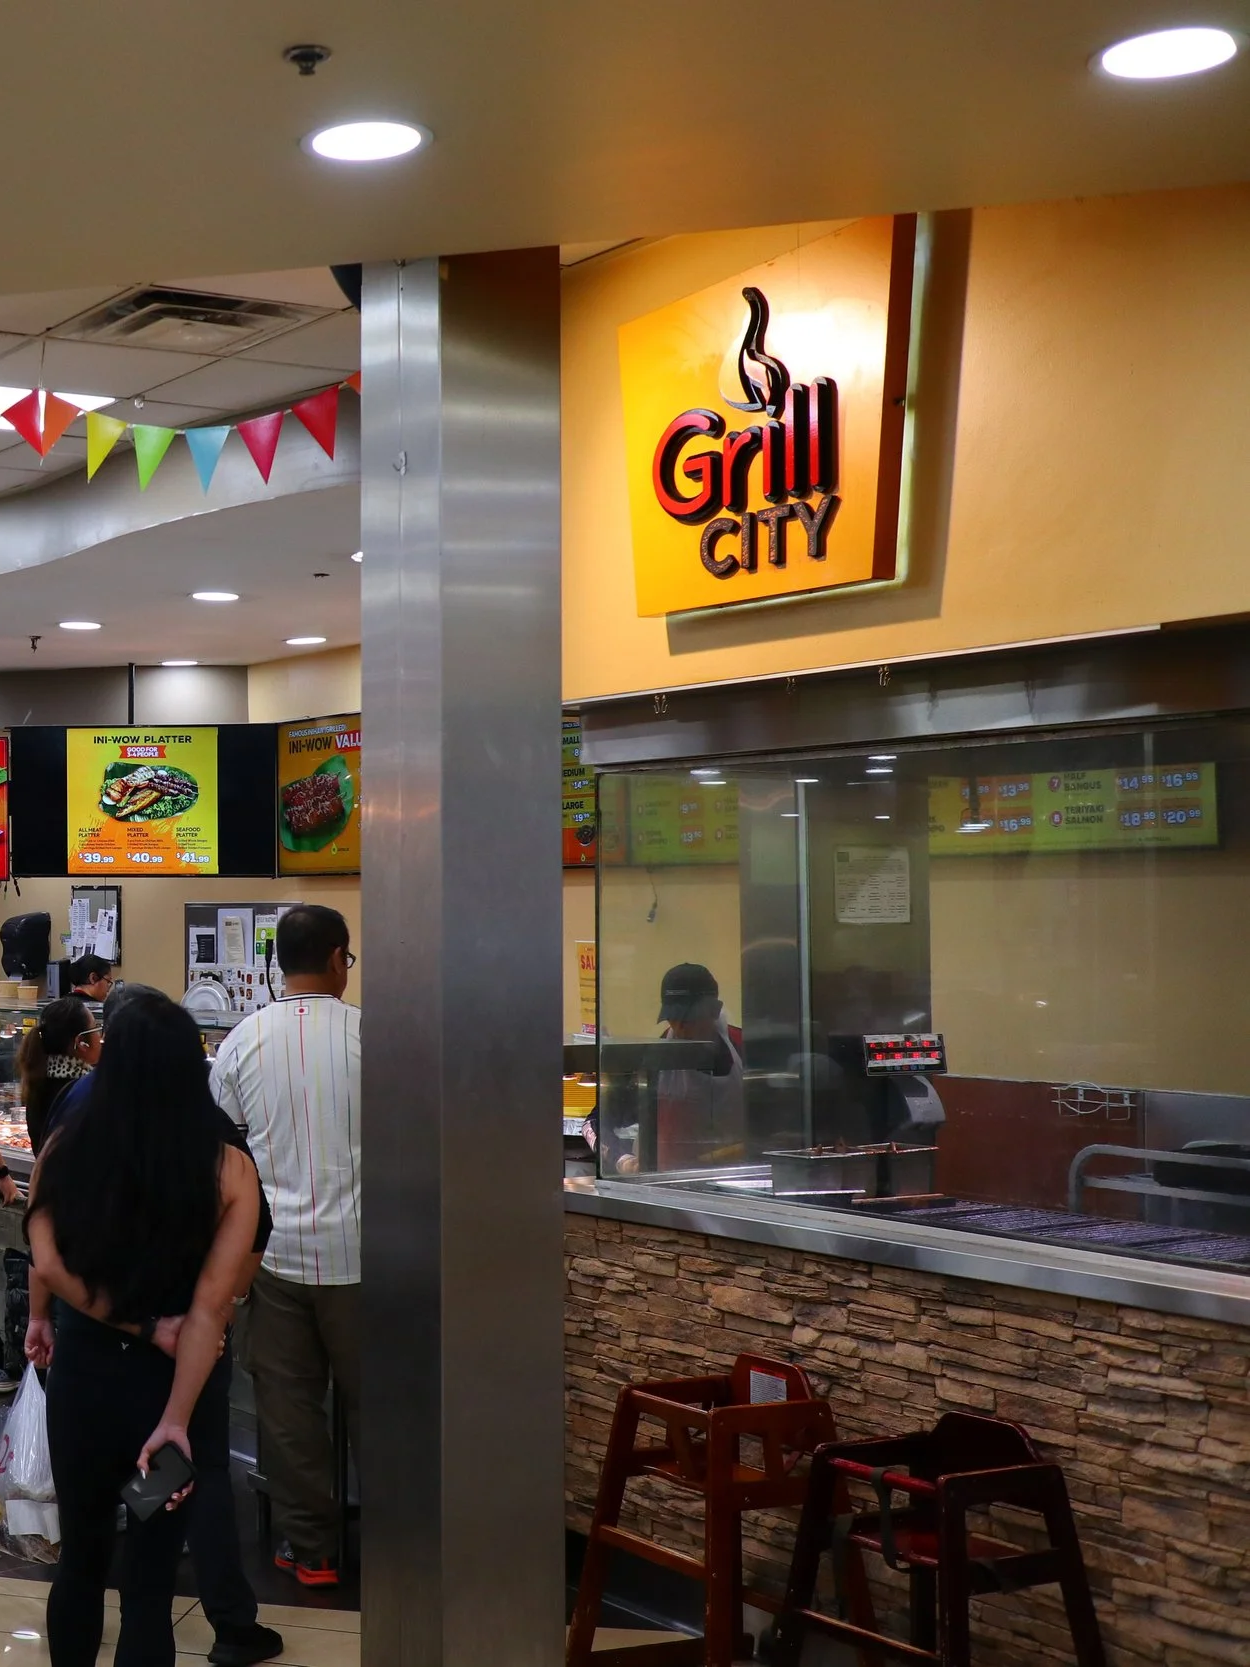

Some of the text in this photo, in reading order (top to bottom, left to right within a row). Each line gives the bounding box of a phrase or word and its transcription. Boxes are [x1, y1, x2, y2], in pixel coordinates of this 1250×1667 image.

[652, 376, 839, 526] Grill
[700, 495, 842, 579] CITY
[93, 735, 192, 744] INI-WOW PLATTER
[288, 731, 362, 754] INI-WOW VALU
[562, 736, 580, 745] MALL
[563, 768, 586, 777] EDIUM
[1064, 772, 1086, 781] HALF
[1064, 781, 1102, 791] BANGUS
[562, 801, 584, 810] LARGE
[1064, 805, 1105, 814] TERIYAKI
[1065, 814, 1103, 825] SALMON
[78, 852, 114, 863] $39.99
[126, 852, 163, 863] $40.99
[176, 852, 210, 863] $41.99
[580, 955, 595, 970] SAL
